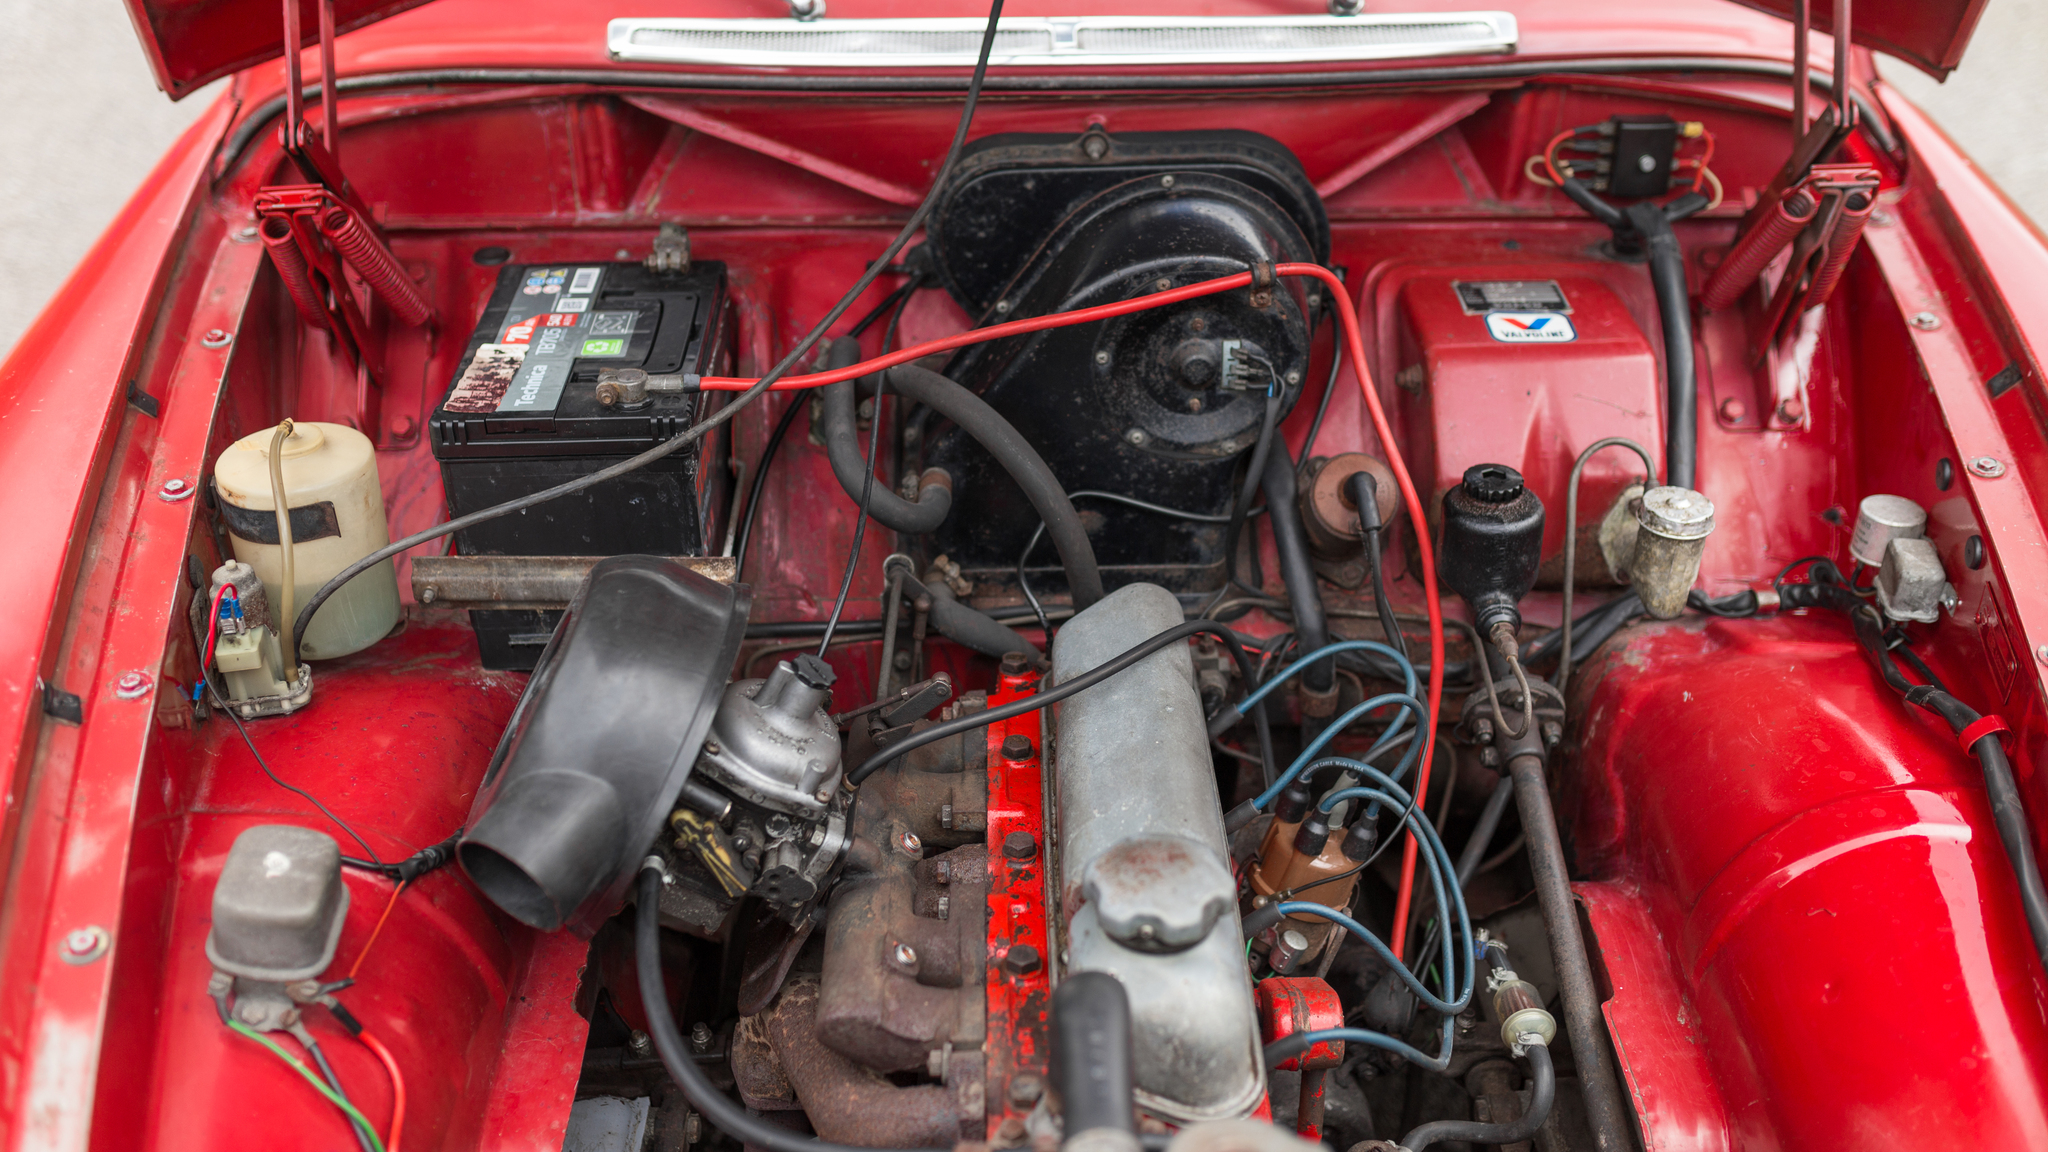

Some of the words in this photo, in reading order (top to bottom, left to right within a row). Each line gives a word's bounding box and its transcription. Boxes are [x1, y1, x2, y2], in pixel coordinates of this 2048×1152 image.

[506, 326, 533, 342] 70
[535, 327, 562, 355] TB705
[1501, 330, 1565, 338] VALVOLINE
[514, 364, 548, 407] Technica
